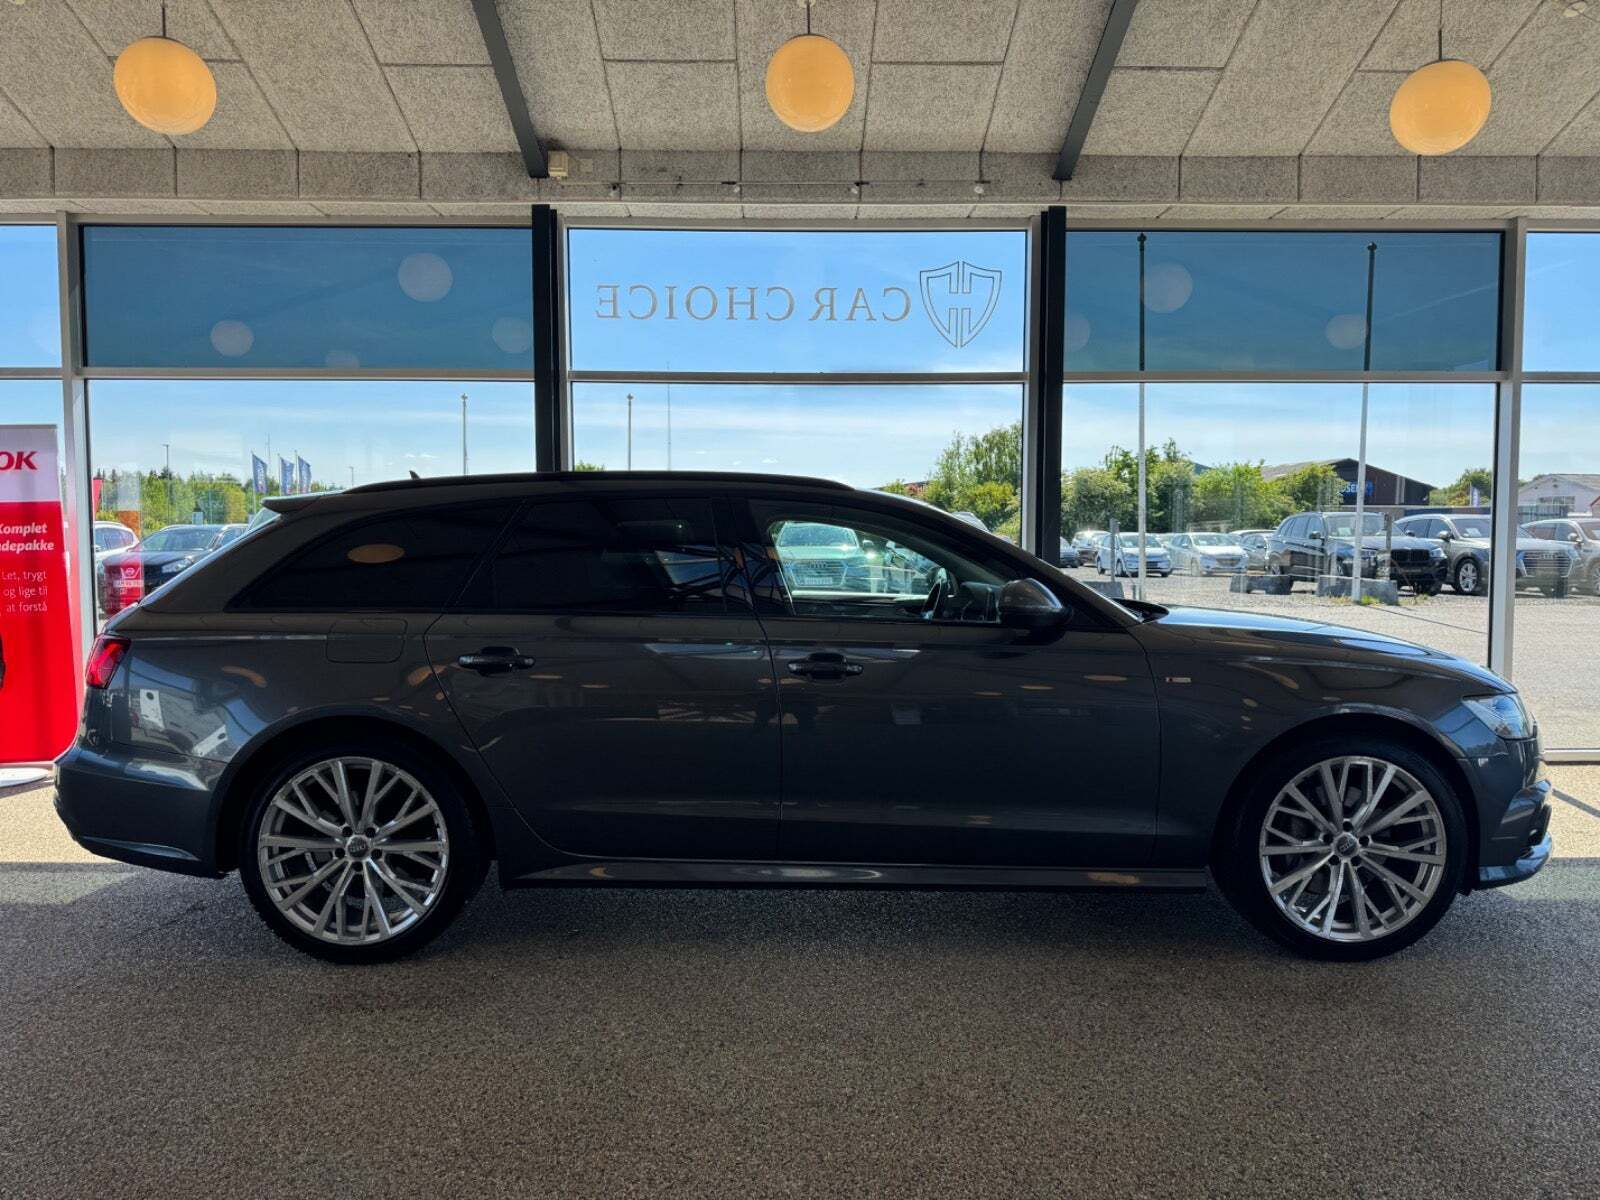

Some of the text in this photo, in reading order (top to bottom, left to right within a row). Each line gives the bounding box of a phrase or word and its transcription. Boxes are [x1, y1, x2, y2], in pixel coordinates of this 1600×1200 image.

[0, 451, 38, 470] OK
[0, 539, 55, 555] depakke
[23, 570, 48, 582] trygt
[3, 588, 16, 599] og
[18, 586, 36, 599] lige
[19, 601, 48, 612] forstå
